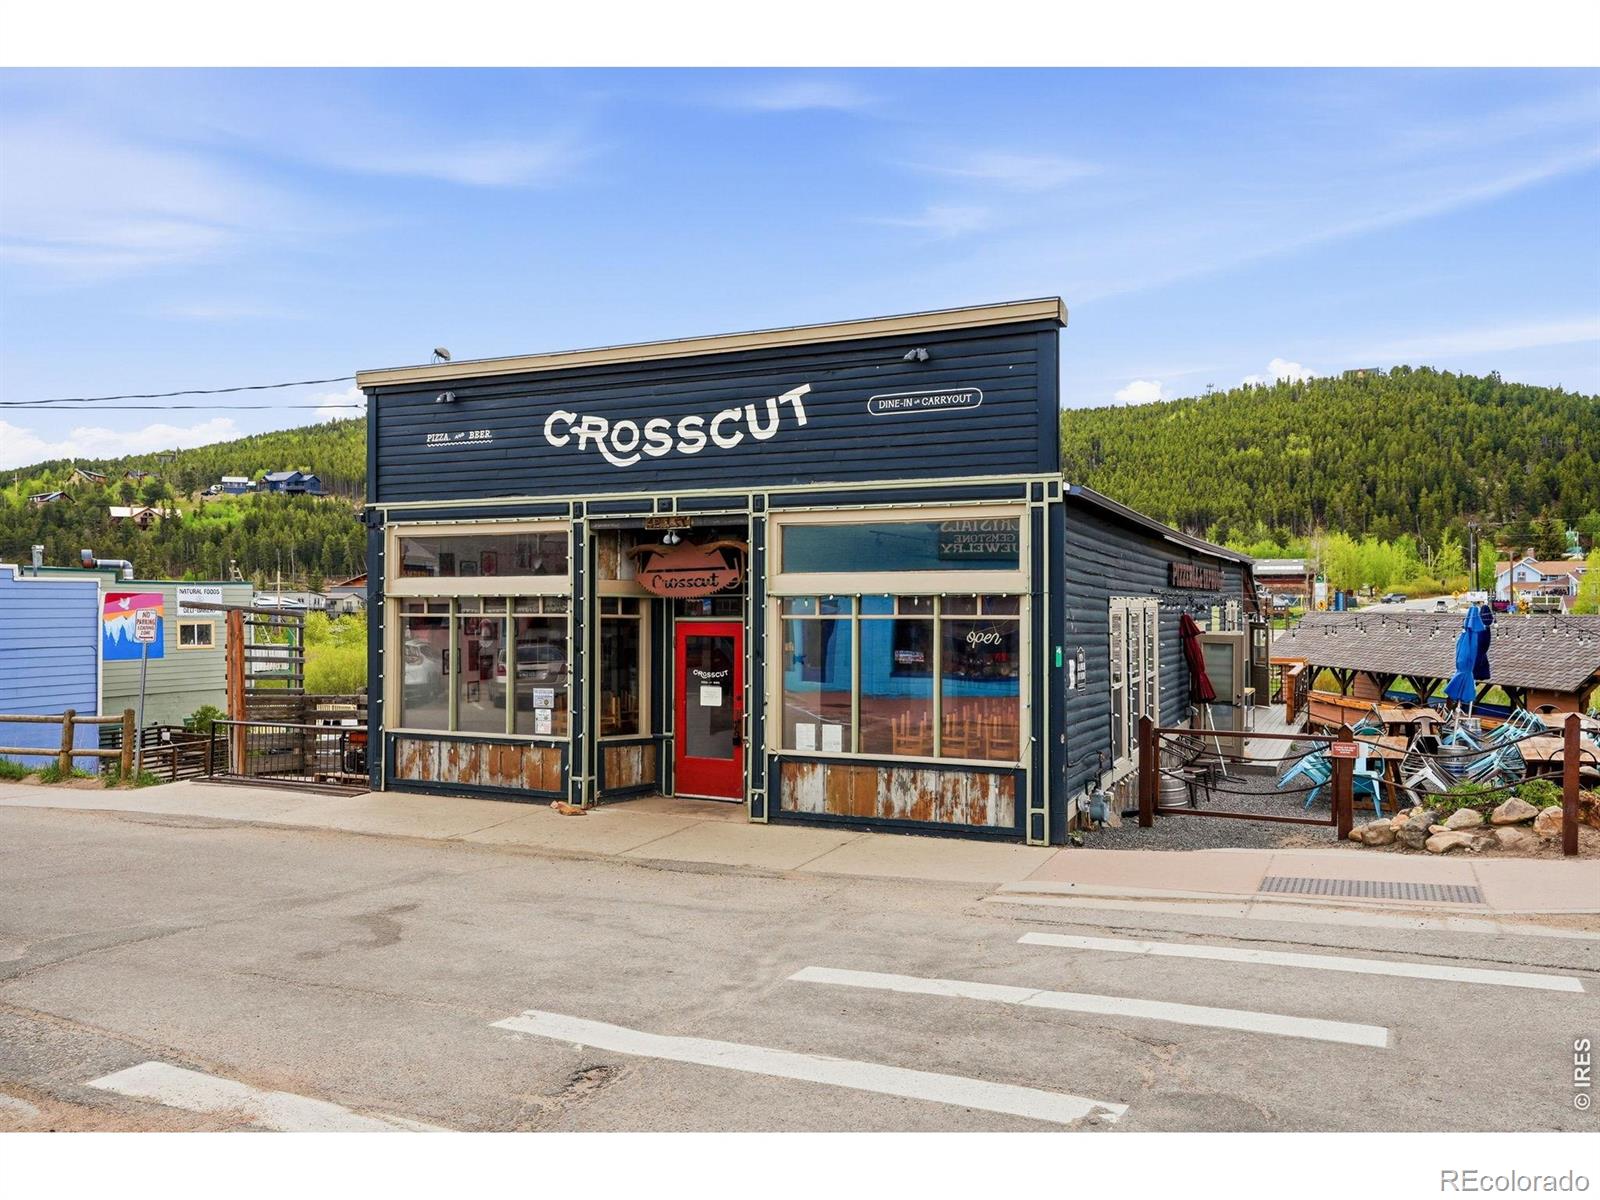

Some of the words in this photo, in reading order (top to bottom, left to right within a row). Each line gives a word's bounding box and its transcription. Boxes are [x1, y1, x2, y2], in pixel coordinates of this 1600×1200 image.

[879, 398, 913, 409] DINE-IN
[921, 394, 972, 406] CARRYOUT
[544, 383, 812, 467] CROSSCUT
[651, 572, 719, 589] Crosscut
[965, 630, 1003, 649] open
[692, 669, 729, 679] CROSSCUT
